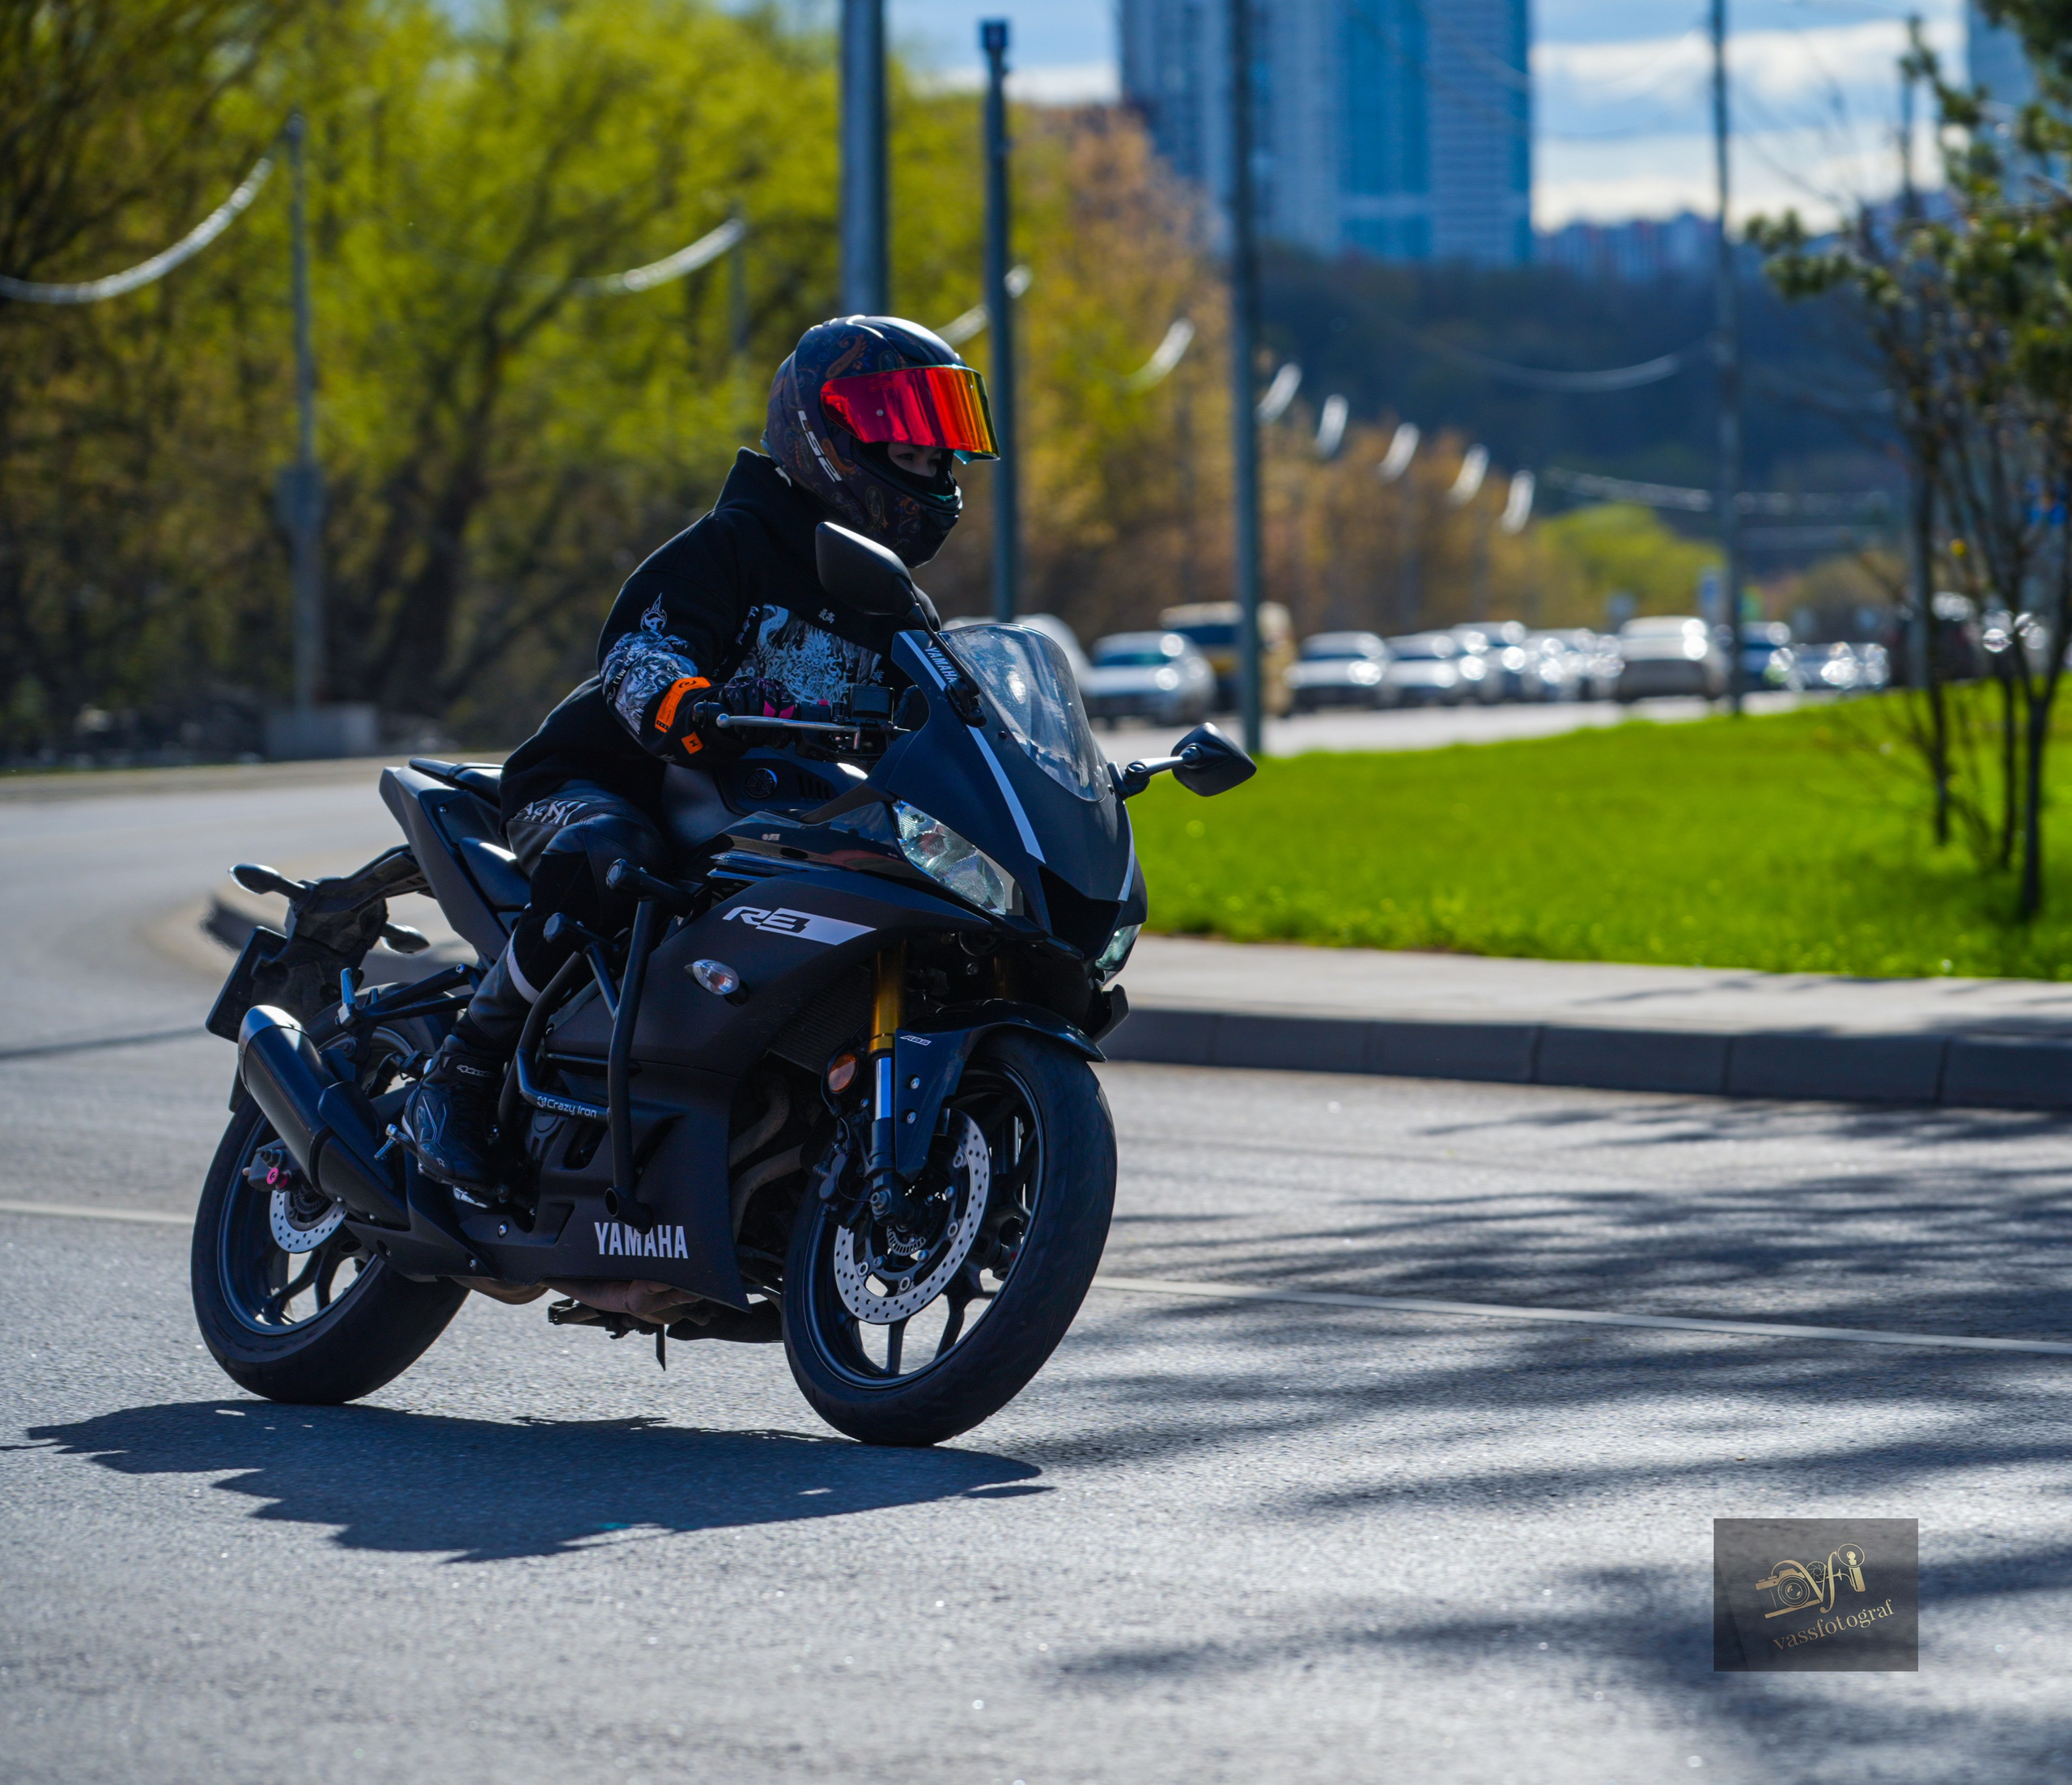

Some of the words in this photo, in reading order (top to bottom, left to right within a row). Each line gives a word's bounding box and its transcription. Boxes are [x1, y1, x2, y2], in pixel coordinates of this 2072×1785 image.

[797, 410, 843, 483] LS2
[924, 647, 958, 683] YAMAHA
[546, 1098, 575, 1116] Crazy
[577, 1105, 597, 1118] Iron
[594, 1222, 688, 1259] YAMAHA
